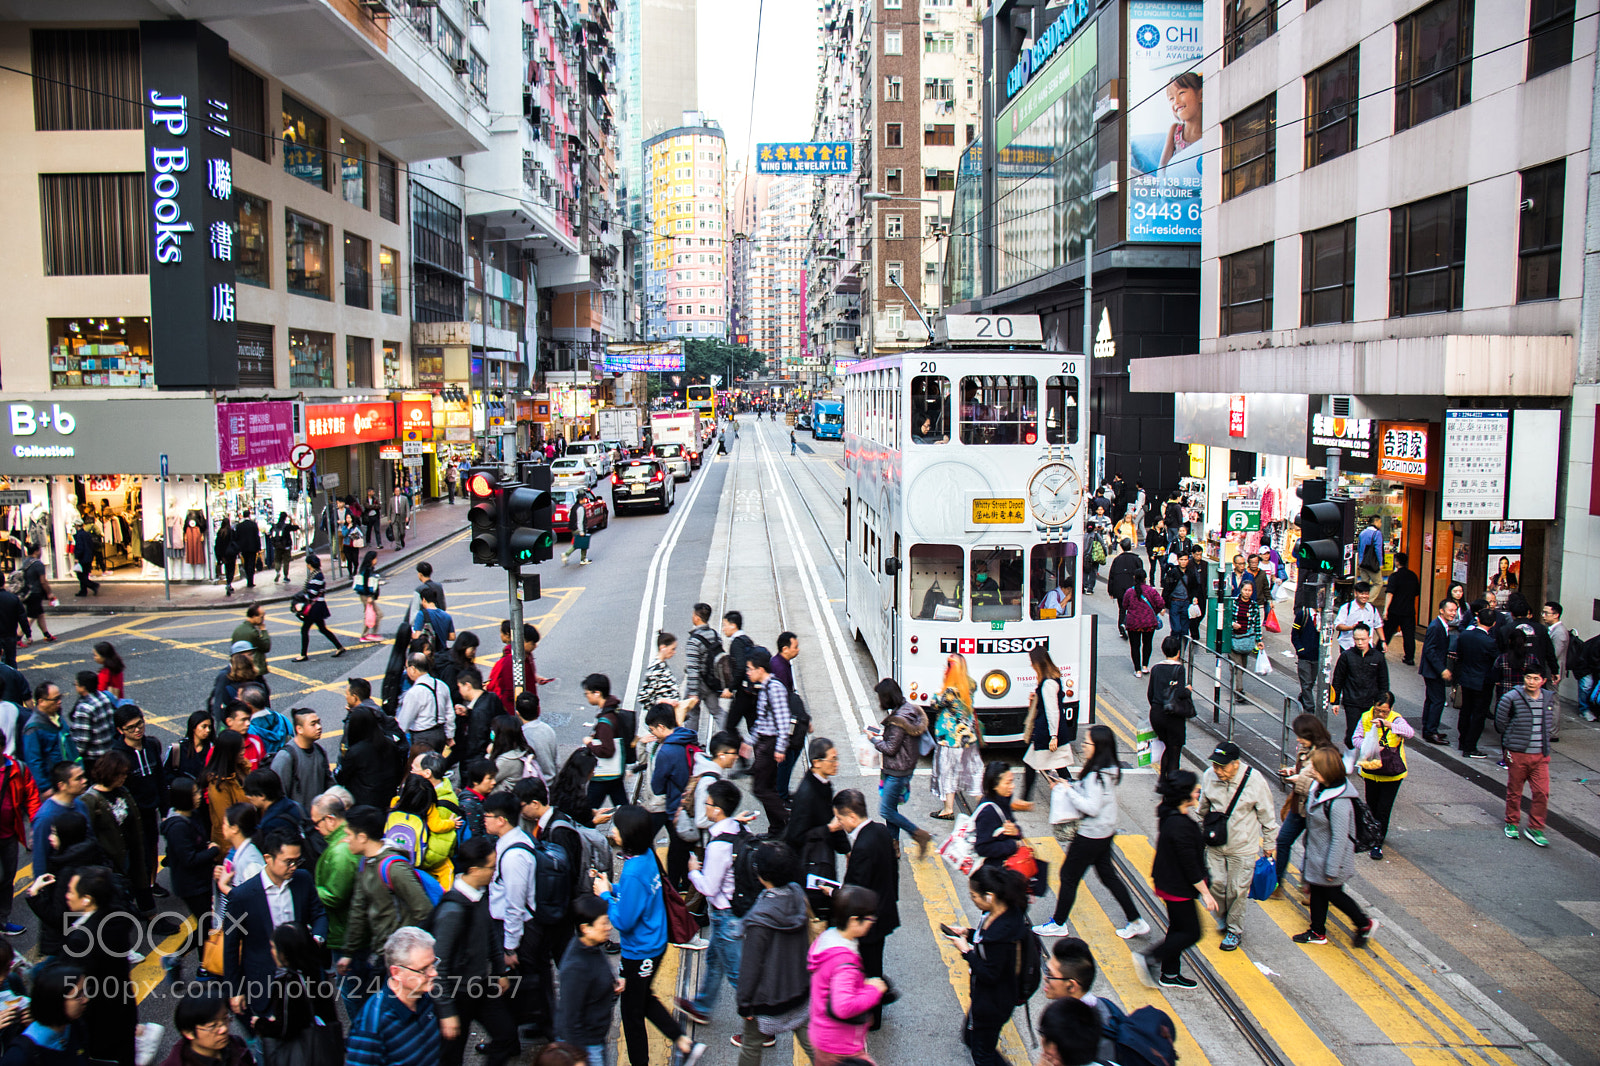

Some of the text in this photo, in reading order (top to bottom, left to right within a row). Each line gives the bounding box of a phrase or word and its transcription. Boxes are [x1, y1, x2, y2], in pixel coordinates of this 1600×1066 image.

[1166, 26, 1198, 43] CHI
[760, 145, 848, 161] 永安珠寶金行
[760, 161, 848, 171] WING ON JEWELRY LTD.
[149, 89, 195, 265] JP Books
[1162, 177, 1180, 187] 138
[1133, 187, 1193, 198] TO ENQUIRE
[207, 99, 236, 323] 三聯書店
[1134, 202, 1202, 221] 3443 6
[975, 316, 1014, 338] 20
[920, 361, 937, 373] 20
[1061, 362, 1076, 374] 20
[13, 444, 76, 458] Collection
[1384, 430, 1426, 459] 吉野家
[1382, 459, 1424, 475] YOSHINOYA
[974, 500, 1024, 510] Whitty Street Depot
[978, 636, 1048, 653] TISSOT
